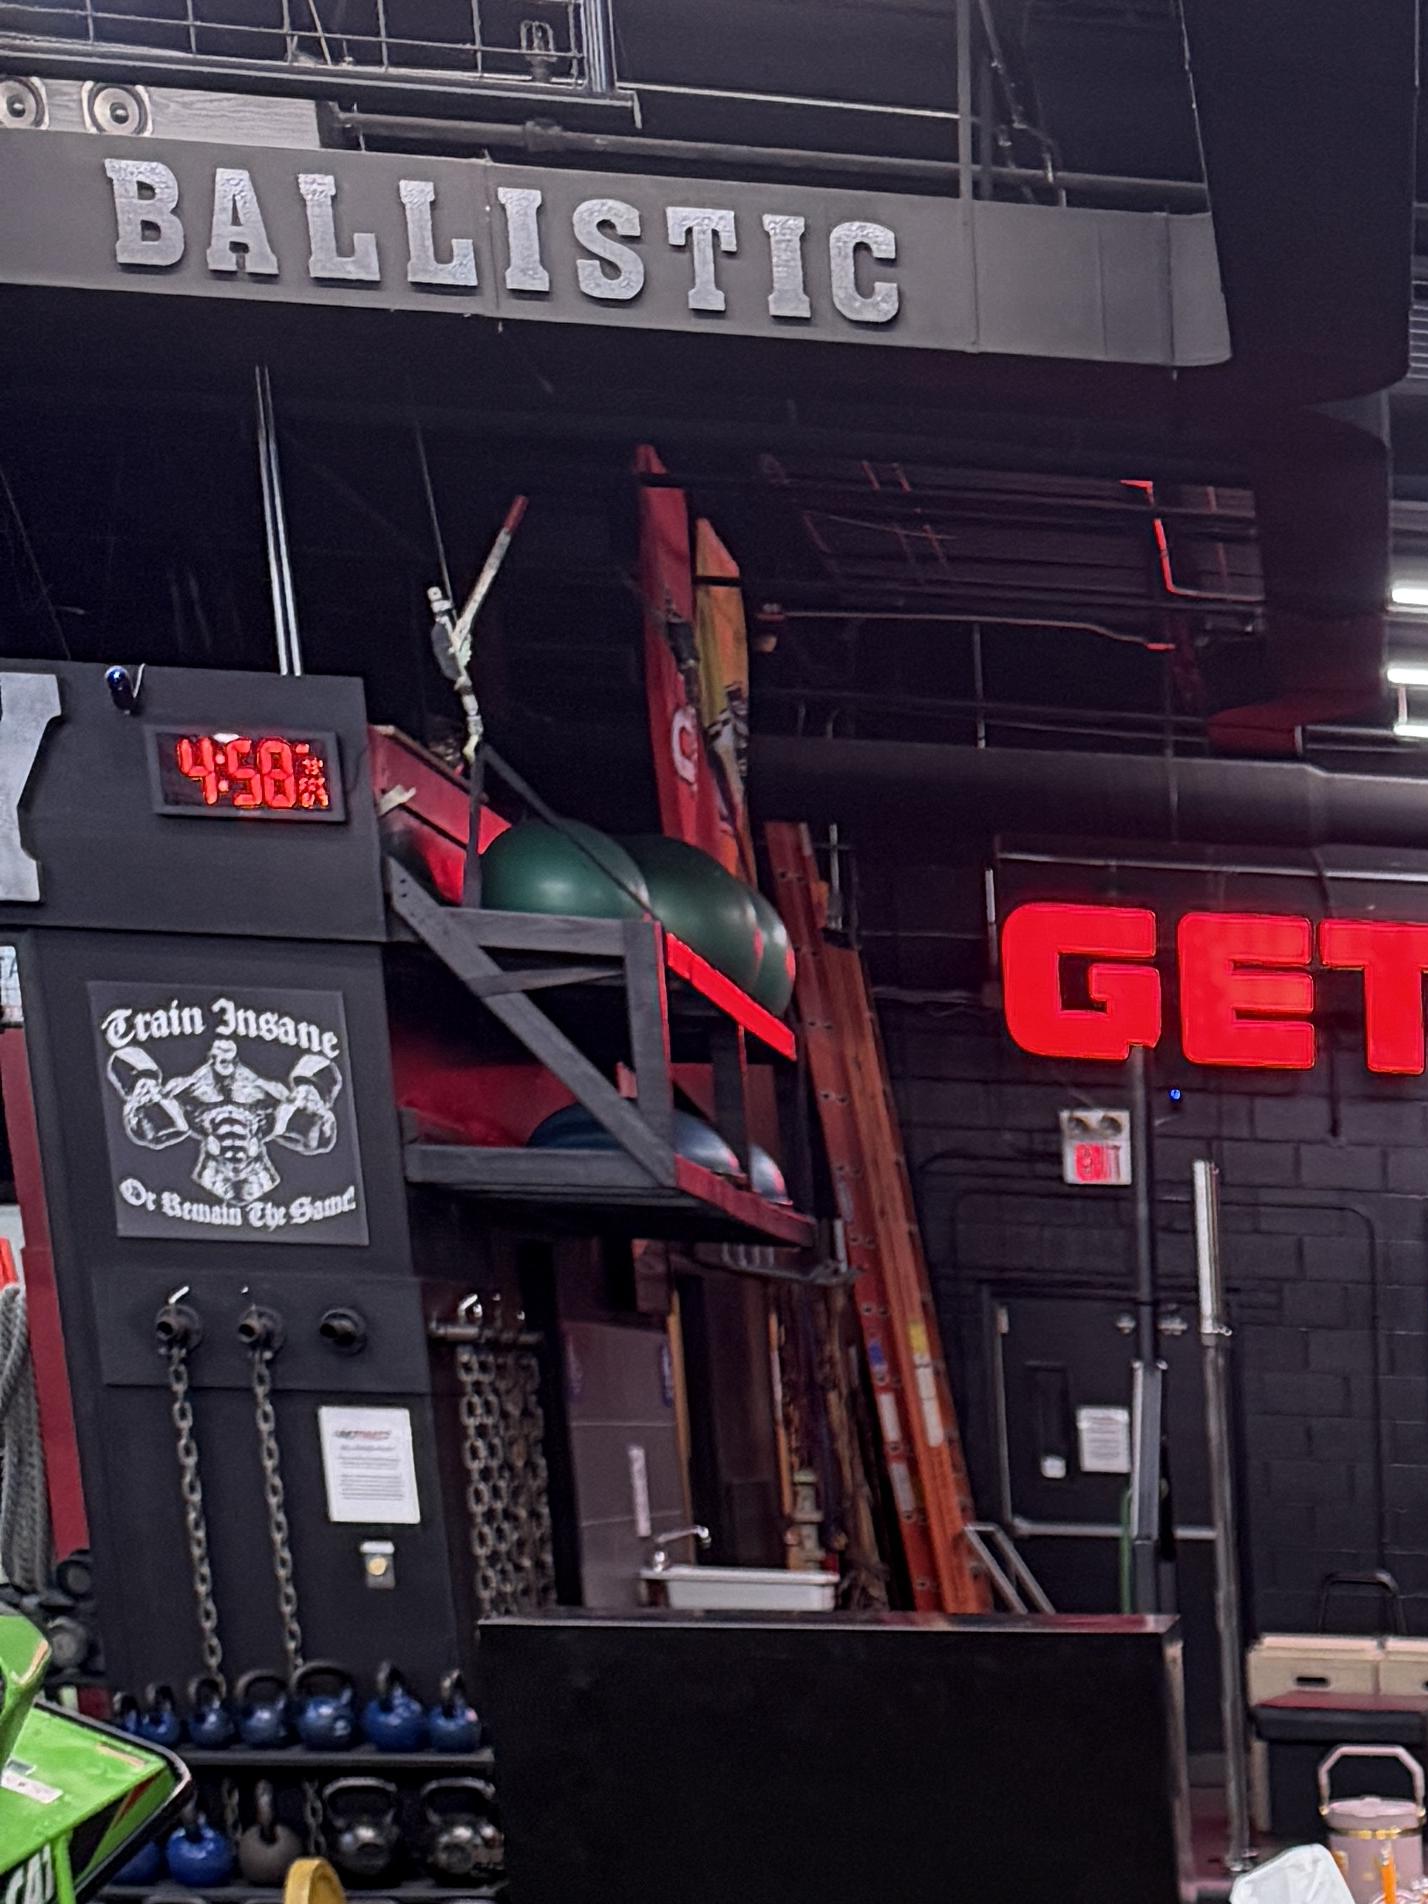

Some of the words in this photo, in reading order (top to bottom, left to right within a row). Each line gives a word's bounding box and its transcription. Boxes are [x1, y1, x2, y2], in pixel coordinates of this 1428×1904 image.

[103, 156, 902, 326] BALLISTIC
[101, 999, 208, 1049] Train
[211, 997, 341, 1060] Insane
